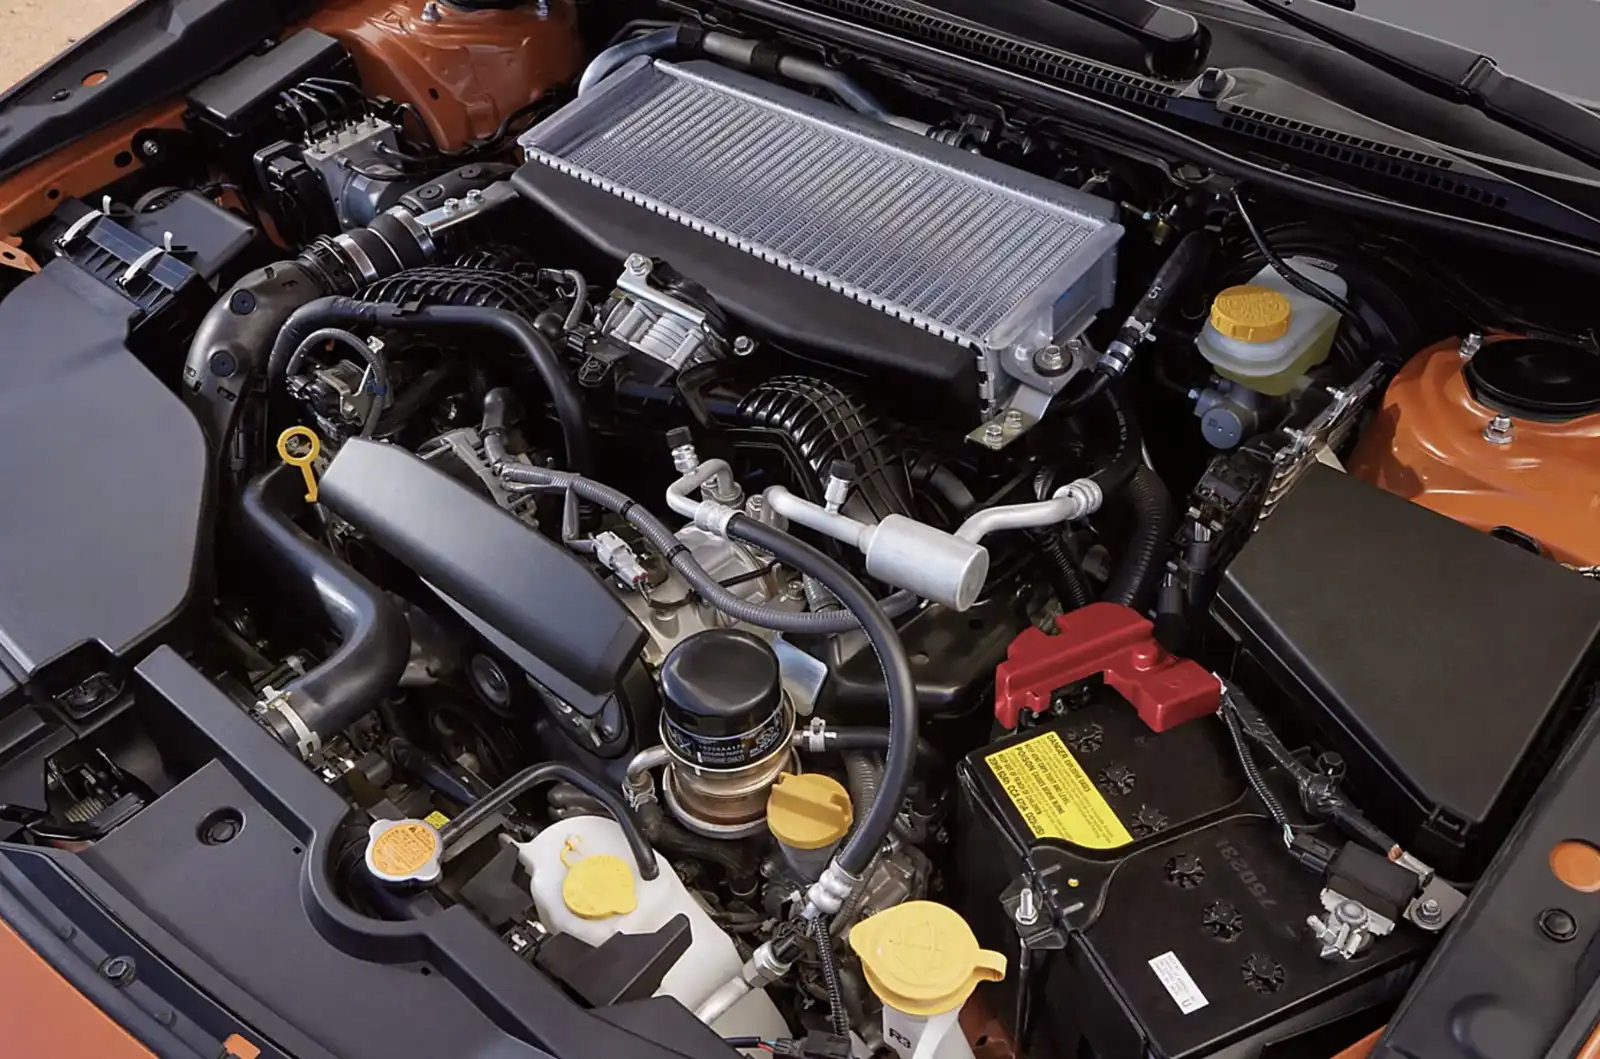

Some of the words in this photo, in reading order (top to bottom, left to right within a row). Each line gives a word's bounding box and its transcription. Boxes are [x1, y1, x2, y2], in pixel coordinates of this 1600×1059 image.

[1047, 734, 1068, 758] DANGER
[1015, 747, 1036, 771] POISON
[1007, 785, 1020, 798] CCA
